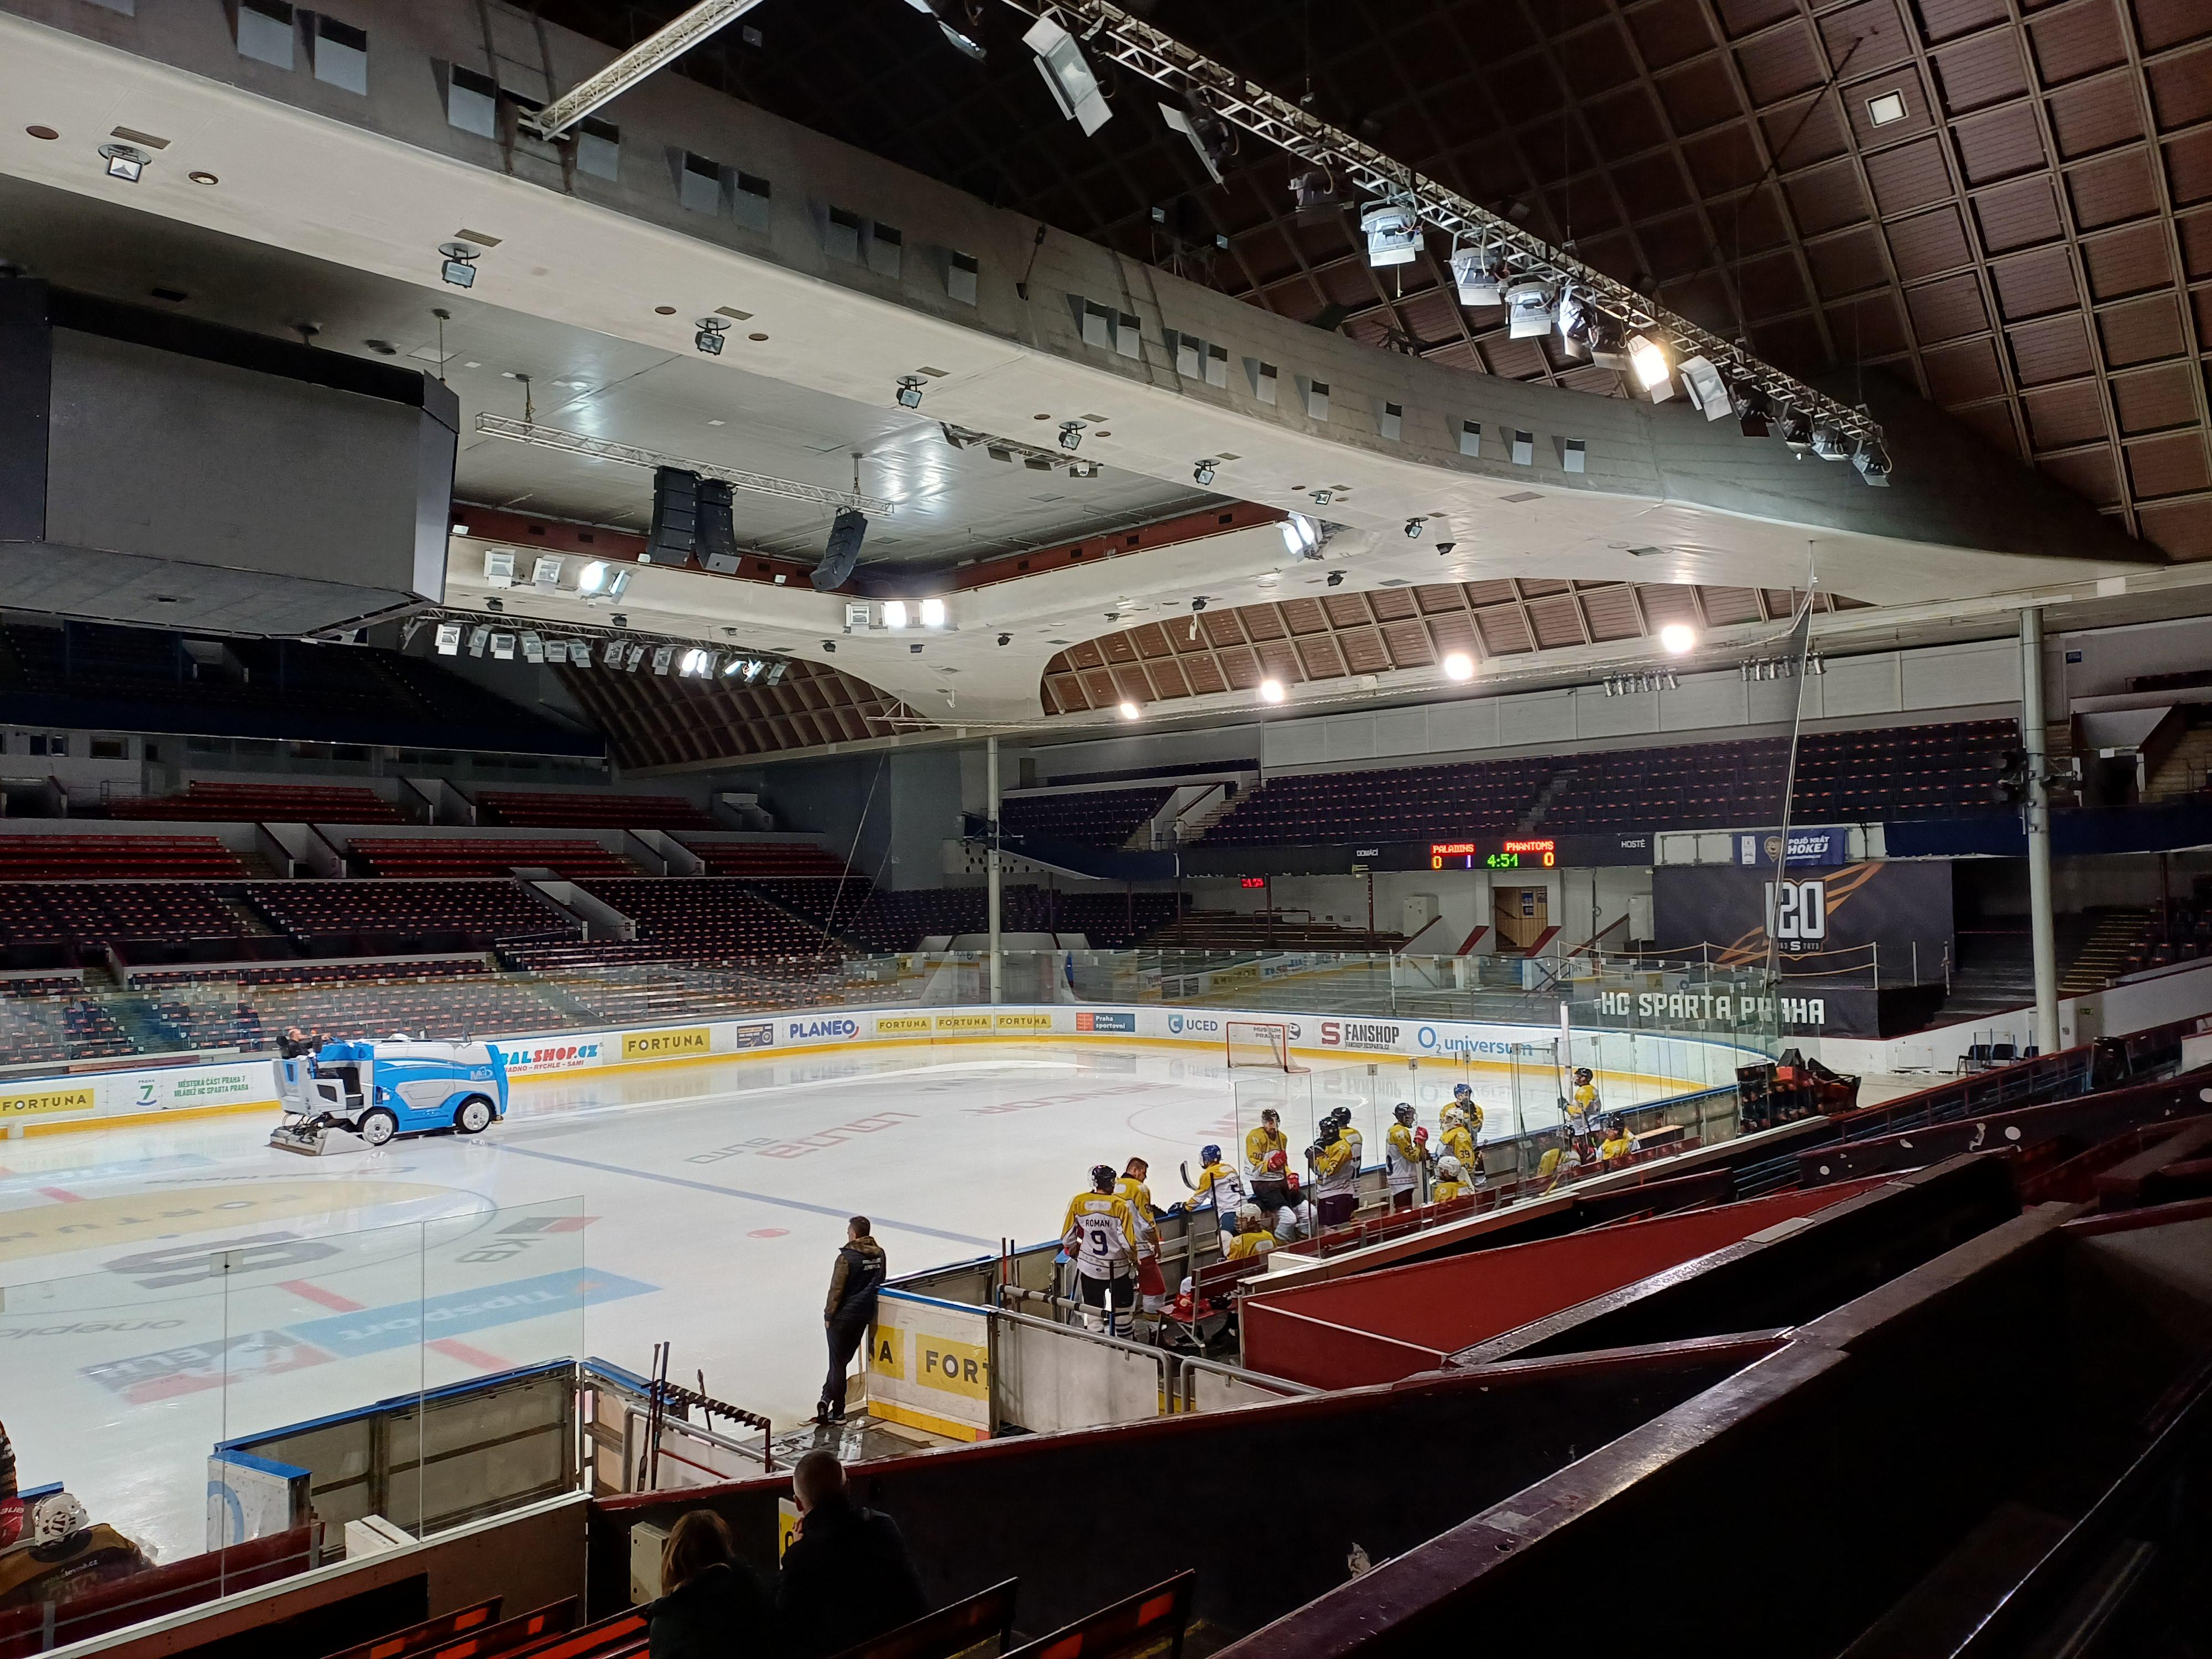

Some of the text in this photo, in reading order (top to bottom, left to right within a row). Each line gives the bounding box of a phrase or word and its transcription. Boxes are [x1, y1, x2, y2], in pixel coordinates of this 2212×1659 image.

[1433, 844, 1474, 853] PALADINS
[1506, 841, 1553, 851] PHANTOMS
[1787, 843, 1829, 854] HOKEJ
[1433, 855, 1442, 869] 0
[1467, 855, 1472, 868] 1
[1544, 852, 1554, 867] 0
[1765, 881, 1825, 938] 120
[1602, 992, 1630, 1016] HC
[1639, 993, 1731, 1020] SPARTA
[790, 1020, 855, 1039] PLANEO
[880, 1020, 927, 1029] FORTUNA
[1186, 1020, 1218, 1031] UCED
[1345, 1024, 1400, 1044] FANSHOP
[628, 1035, 704, 1052] FORTUNA
[140, 1085, 154, 1100] 7
[207, 1086, 229, 1094] SPARTA
[3, 1094, 87, 1112] FORTUNA
[1459, 1150, 1470, 1159] 39
[1086, 1219, 1110, 1228] ROMAN
[1090, 1230, 1108, 1256] 9
[337, 1290, 563, 1340] Tipsport
